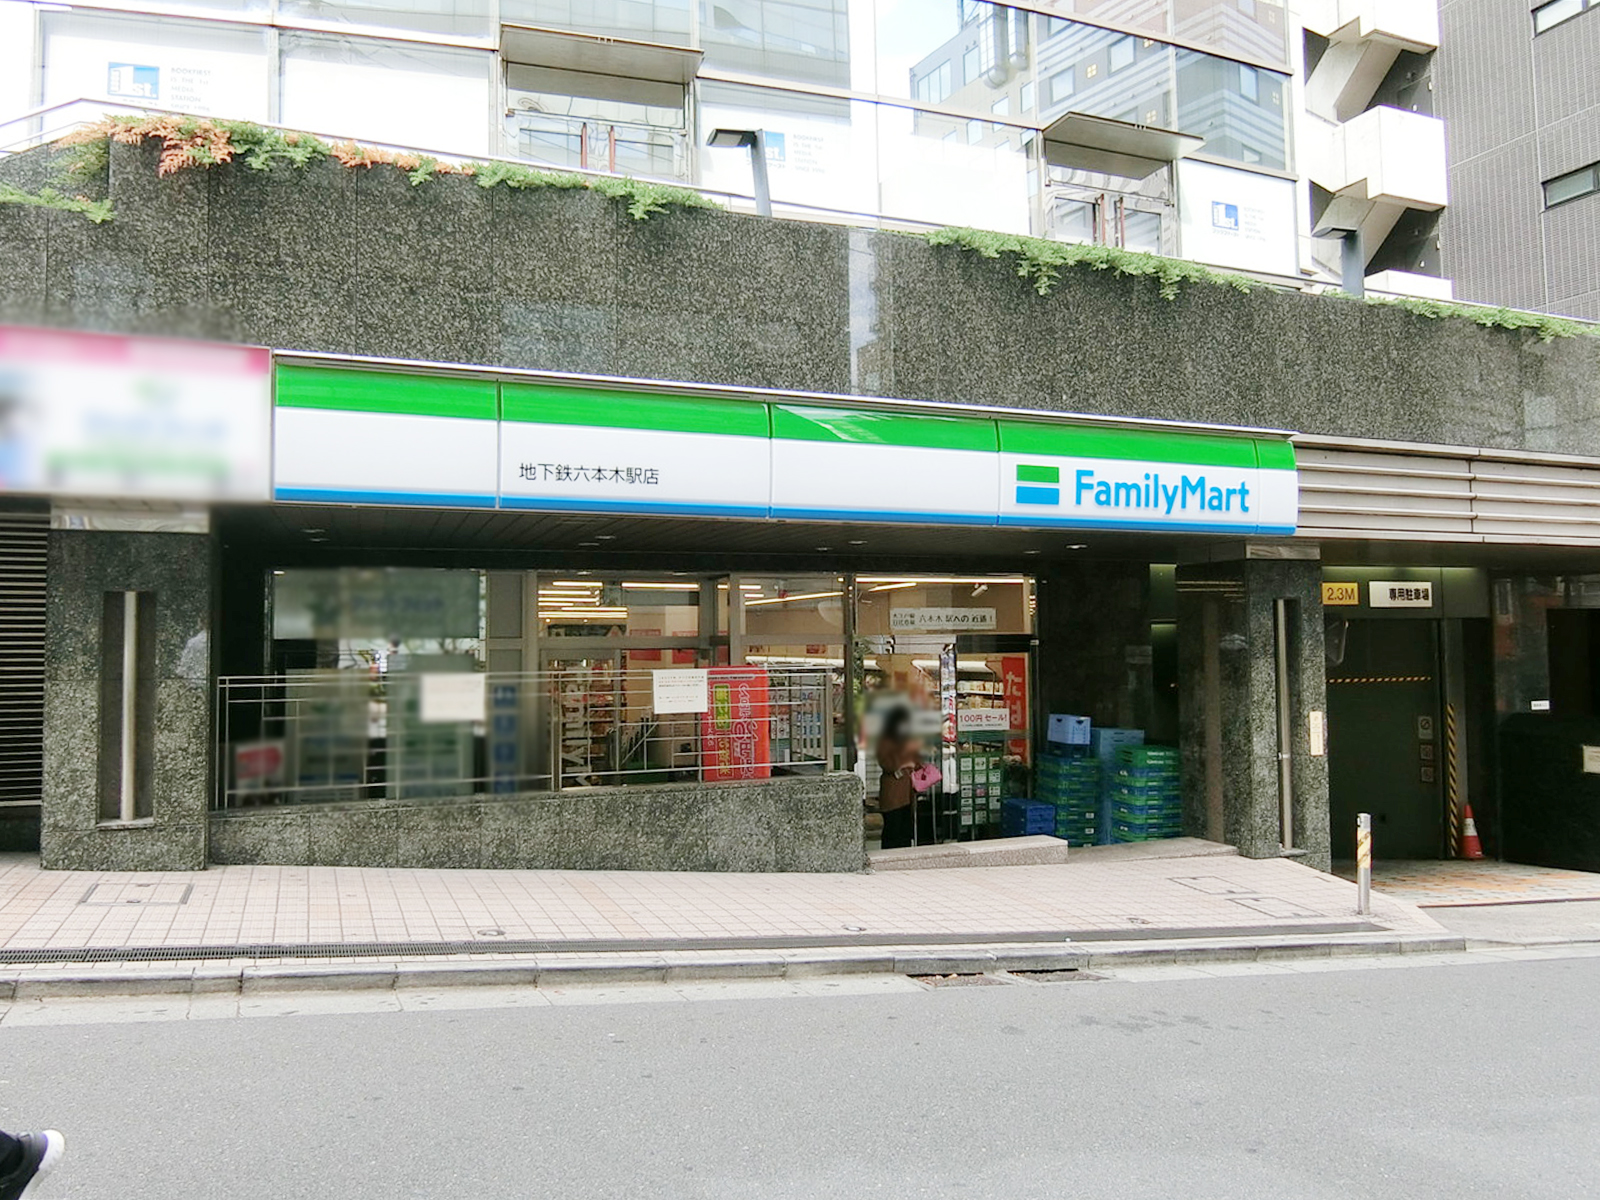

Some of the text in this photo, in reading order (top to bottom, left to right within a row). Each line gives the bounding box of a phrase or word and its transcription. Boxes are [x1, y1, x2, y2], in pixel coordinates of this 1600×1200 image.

[519, 463, 659, 485] 地下鉄六本木駅店
[1075, 469, 1250, 515] FamilyMart
[1327, 587, 1355, 601] 2.3M
[1388, 588, 1430, 601] 専用駐車場
